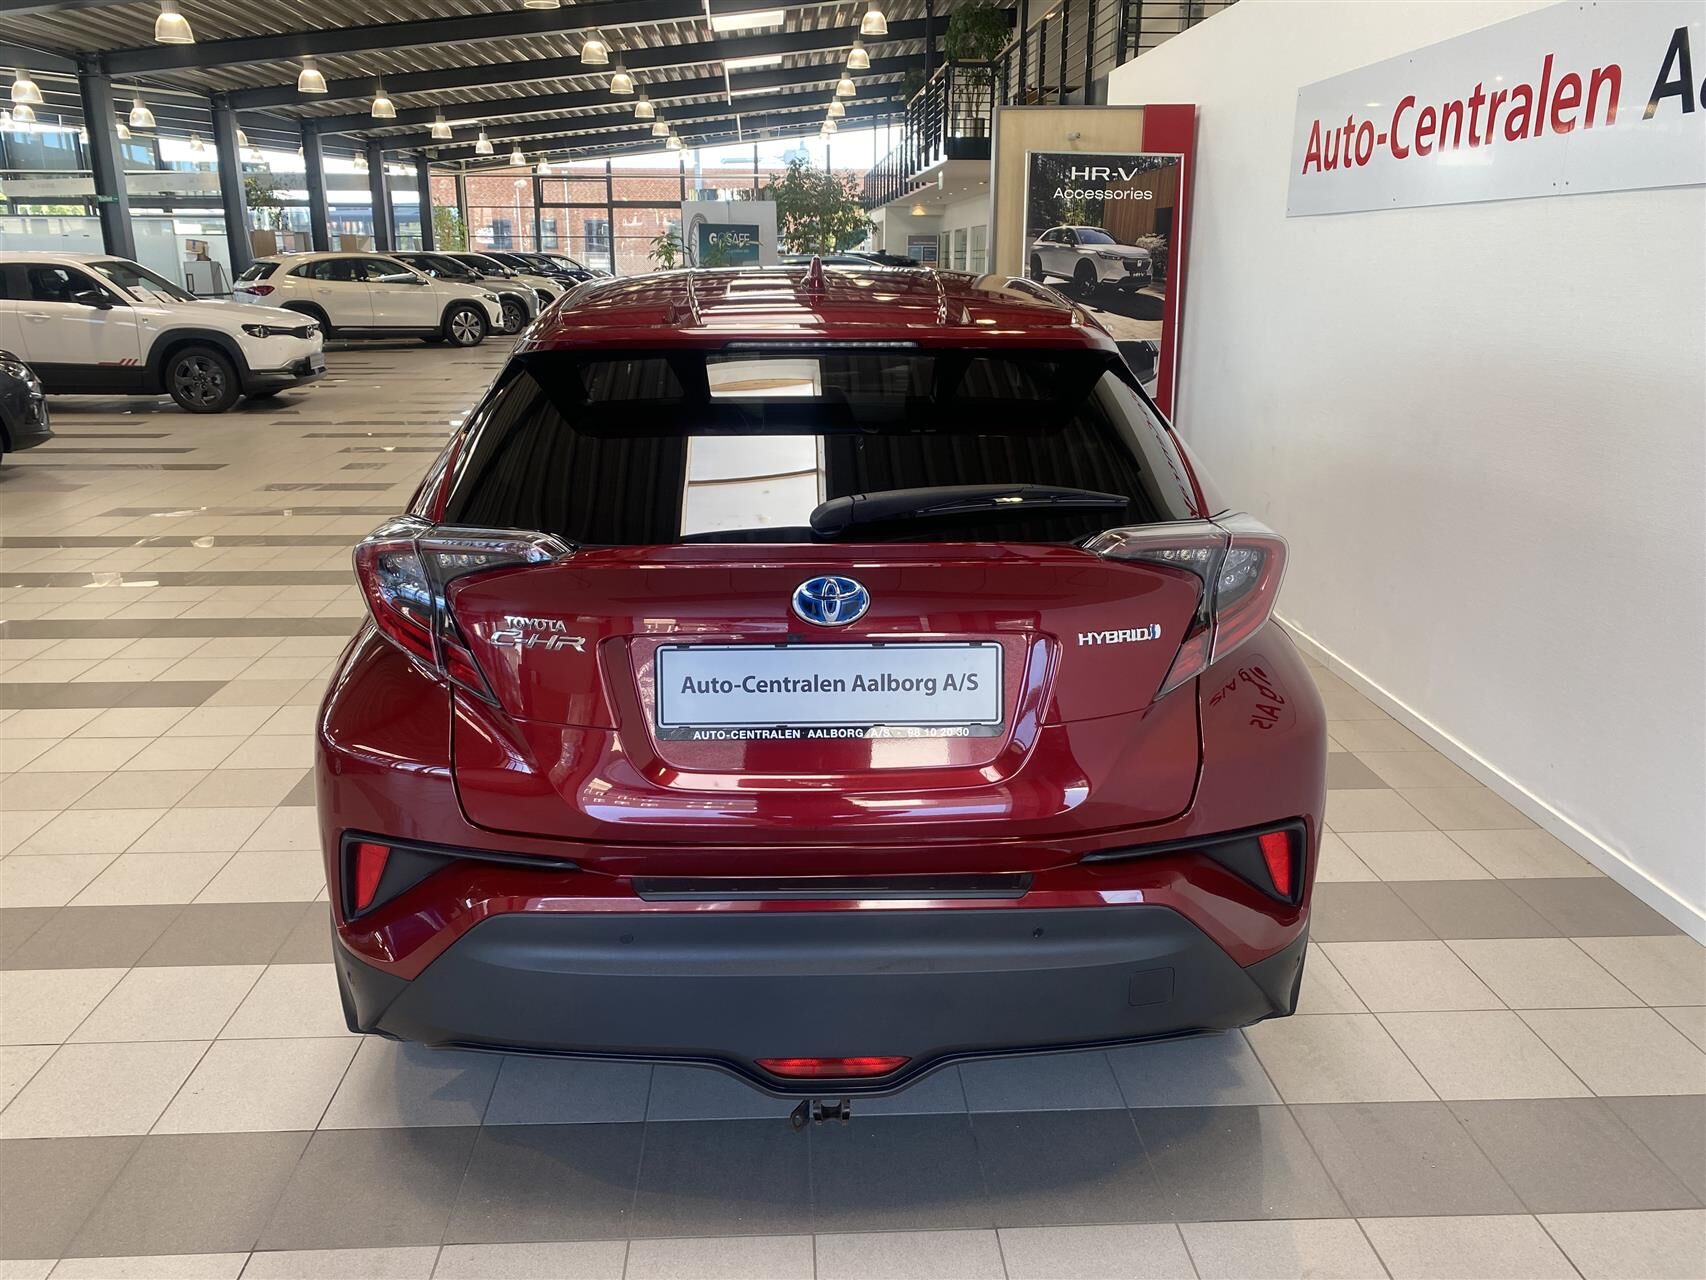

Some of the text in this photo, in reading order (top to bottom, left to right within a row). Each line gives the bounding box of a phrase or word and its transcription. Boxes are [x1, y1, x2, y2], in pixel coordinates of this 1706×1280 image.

[1302, 25, 1706, 175] Auto-Centralen A
[1071, 166, 1138, 181] HR-V
[1053, 187, 1153, 200] Accessories
[504, 615, 567, 633] TOYOTA
[490, 630, 586, 652] C-HR
[1078, 628, 1149, 646] HYBRID
[681, 673, 979, 696] Auto-Centralen Aalborg A/S
[693, 728, 970, 740] AUTO-CENTRALEN AALBORG A/S 98 10 20 30
